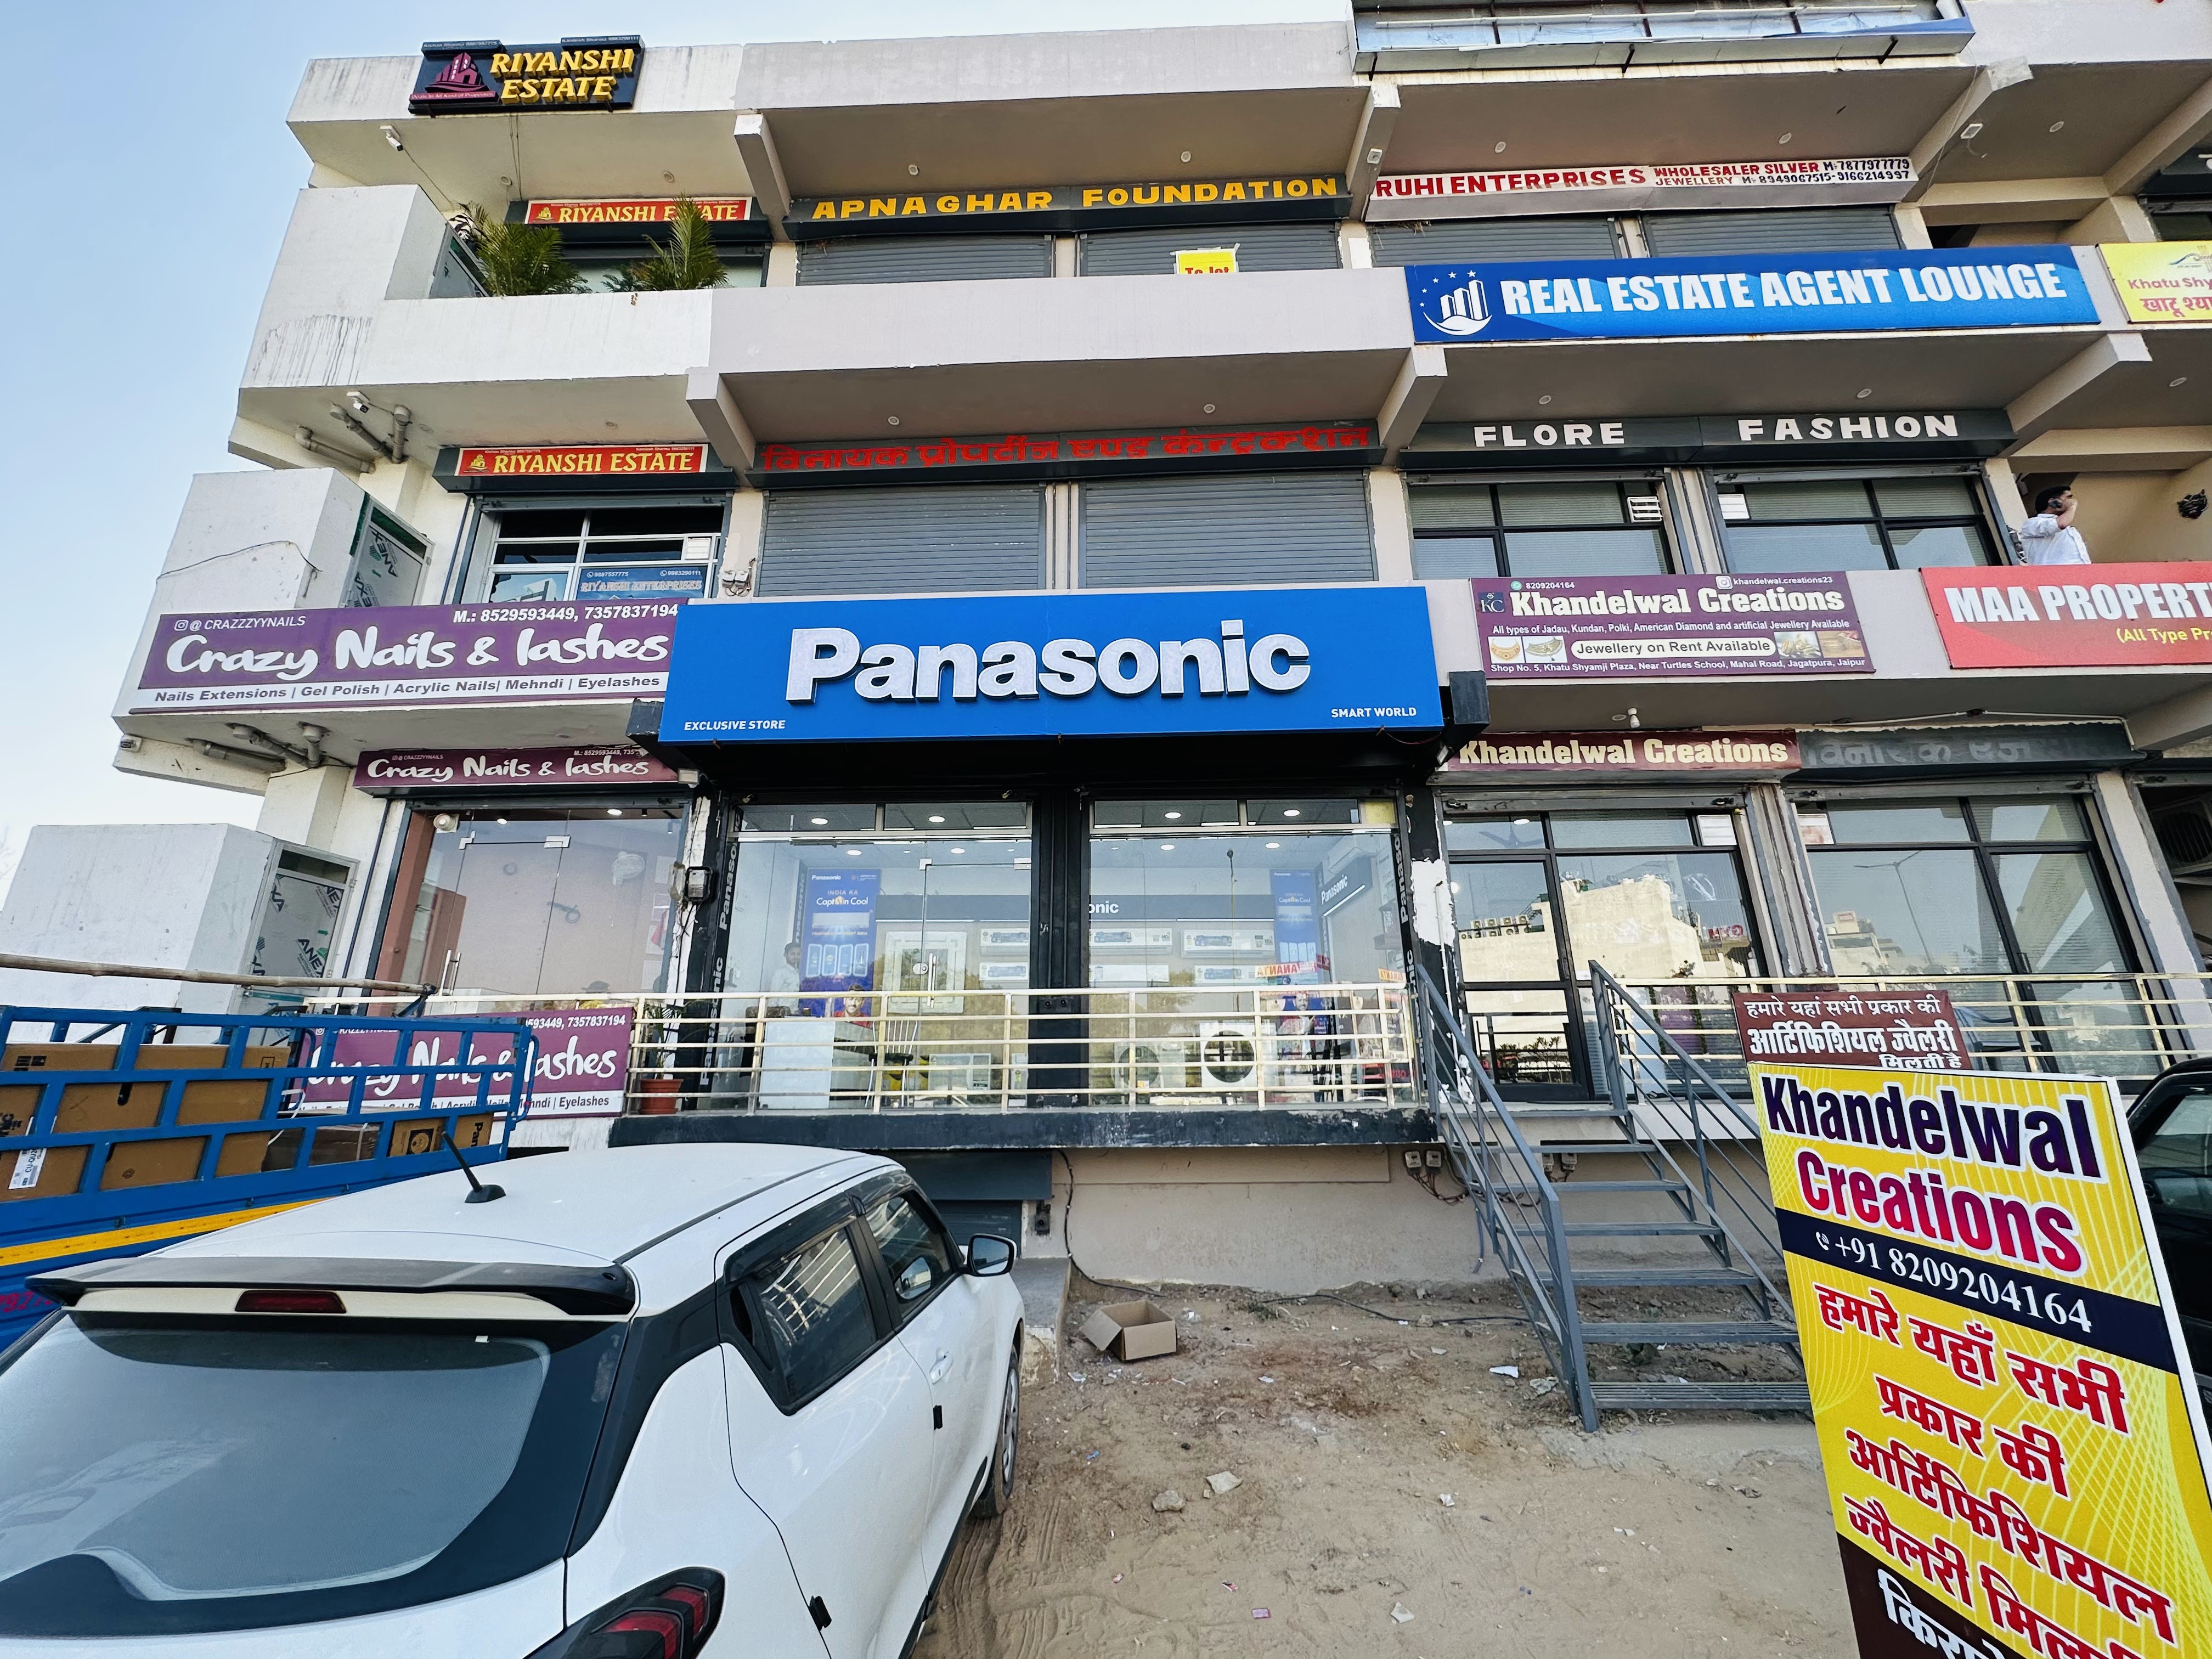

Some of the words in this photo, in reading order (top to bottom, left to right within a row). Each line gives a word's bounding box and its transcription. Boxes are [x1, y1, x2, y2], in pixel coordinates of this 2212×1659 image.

[489, 49, 635, 77] RIYANSHI
[500, 76, 616, 105] ESTATE
[1654, 165, 1759, 177] WHOLESALER
[1765, 162, 1819, 173] SILVER
[1837, 159, 1909, 171] 7877977779
[1655, 177, 1733, 185] JEWELLERY
[1376, 177, 1443, 197] RUHI
[1451, 169, 1646, 194] ENTERPRISES
[812, 196, 927, 219] APNA
[936, 191, 1052, 213] GHAR
[1083, 178, 1337, 207] FOUNDATION
[558, 206, 656, 223] RIYANSHI
[663, 205, 739, 221] EATE
[1500, 279, 1602, 316] REAL
[1610, 273, 1754, 312] ESTATE
[1760, 269, 1891, 308] AGENT
[1903, 263, 2067, 303] LOUNGE
[2128, 279, 2180, 289] Khatu
[2182, 277, 2212, 290] Shy
[1474, 422, 1625, 447] FLORE
[1737, 415, 1958, 441] FASHION
[493, 453, 602, 473] RIYANSHI
[610, 453, 694, 472] ESTATE
[761, 444, 911, 471] विनायक
[370, 529, 399, 578] ANEX
[1509, 589, 1691, 617] Khandelwal
[1697, 586, 1845, 613] Creations
[1943, 586, 2039, 623] MAA
[2037, 582, 2212, 621] PROPERT
[205, 616, 306, 630] CRAZZZYYNAILS
[480, 608, 579, 623] 8529593449,
[584, 603, 679, 619] 7357837194
[1493, 625, 1504, 634] All
[1506, 626, 1530, 635] types
[1531, 625, 1540, 633] of
[1542, 624, 1570, 634] Jadau,
[1571, 624, 1607, 634] Kundan,
[1609, 623, 1632, 633] Polki,
[1634, 622, 1673, 632] American
[1675, 621, 1713, 631] Diamond
[1716, 622, 1731, 630] and
[1734, 620, 1768, 630] artificial
[1769, 620, 1809, 630] Jewellery
[1811, 620, 1849, 629] Available
[1577, 643, 1641, 656] Jewellery
[1647, 644, 1664, 652] on
[1669, 641, 1702, 652] Rent
[1706, 640, 1770, 652] Available
[2147, 628, 2188, 644] Type
[166, 634, 319, 681] Crazy
[336, 625, 456, 670] Nails
[466, 636, 499, 665] &
[517, 622, 669, 666] lashes
[786, 619, 1311, 704] Panasonic
[1491, 664, 1514, 673] Shop
[1544, 663, 1570, 672] Khatu
[1572, 663, 1608, 672] Shyamji
[1610, 662, 1637, 671] Plaza,
[1662, 661, 1692, 669] Turtles
[1694, 661, 1728, 669] School,
[1730, 660, 1757, 668] Mahal
[1759, 659, 1785, 668] Road,
[1787, 659, 1835, 669] Jagatpura,
[1837, 659, 1865, 667] Jaipur
[155, 691, 194, 702] Nails
[199, 687, 287, 700] Extensions
[301, 686, 326, 696] Gel
[331, 684, 380, 695] Polish
[393, 682, 450, 695] Acrylic
[505, 678, 563, 690] Mehndi
[578, 676, 660, 688] Eyelashes
[684, 720, 747, 731] EXCLUSIVE
[749, 720, 786, 730] STORE
[1331, 708, 1371, 718] SMART
[1374, 707, 1417, 717] WORLD
[1459, 739, 1636, 764] Khandelwal
[1643, 738, 1788, 763] Creations
[367, 759, 453, 782] Crazy
[462, 755, 531, 778] Nails
[538, 761, 556, 775] &
[565, 755, 650, 776] lashes
[850, 896, 868, 905] Cool
[1321, 874, 1348, 905] Panasonic
[1743, 995, 1786, 1018] हमारे
[1787, 996, 1821, 1018] यहां
[1823, 996, 1865, 1017] सभी
[1865, 999, 1914, 1017] प्रकार
[1914, 993, 1942, 1014] की
[567, 1014, 626, 1028] 7357837194
[1944, 1052, 1962, 1069] है
[558, 1096, 610, 1110] Eyelashes
[1760, 1075, 2102, 1179] Khandelwal
[1797, 1150, 2083, 1272] Creations
[1834, 1235, 1882, 1271] +91
[1889, 1247, 2092, 1333] 8209204164
[1814, 1284, 1899, 1346] हमारे
[1908, 1321, 1998, 1387] यहाँ
[2005, 1357, 2130, 1435] सभी
[1875, 1375, 1985, 1459] प्रकार
[1994, 1423, 2071, 1499] की
